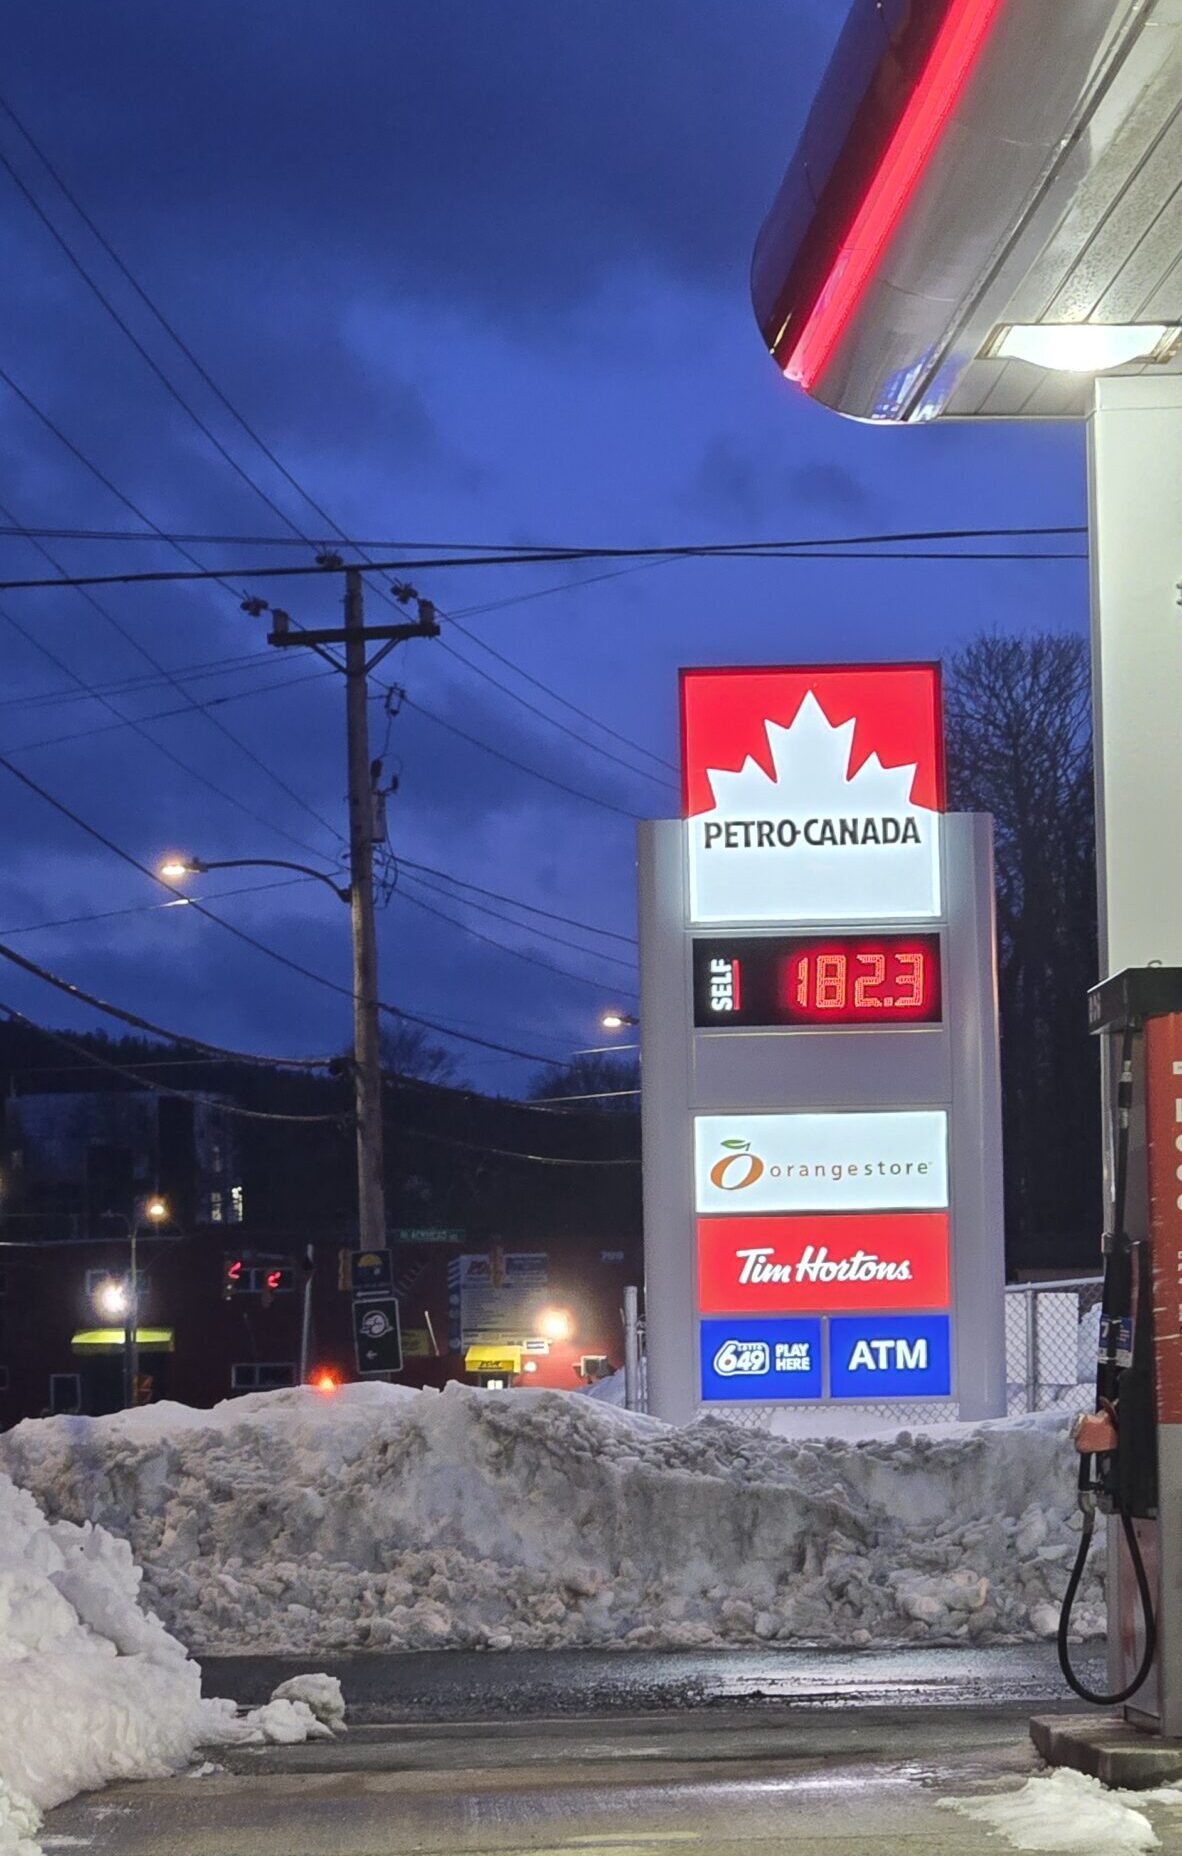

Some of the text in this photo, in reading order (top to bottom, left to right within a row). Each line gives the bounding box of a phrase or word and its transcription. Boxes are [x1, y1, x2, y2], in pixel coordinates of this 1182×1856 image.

[710, 957, 733, 1012] SELF
[796, 952, 924, 1008] 182.3
[769, 1160, 929, 1181] orangestore
[735, 1244, 911, 1284] Tim Hortons
[717, 1344, 766, 1373] 649
[775, 1342, 809, 1358] PLAY
[775, 1356, 811, 1372] HERE
[848, 1338, 928, 1371] ATM
